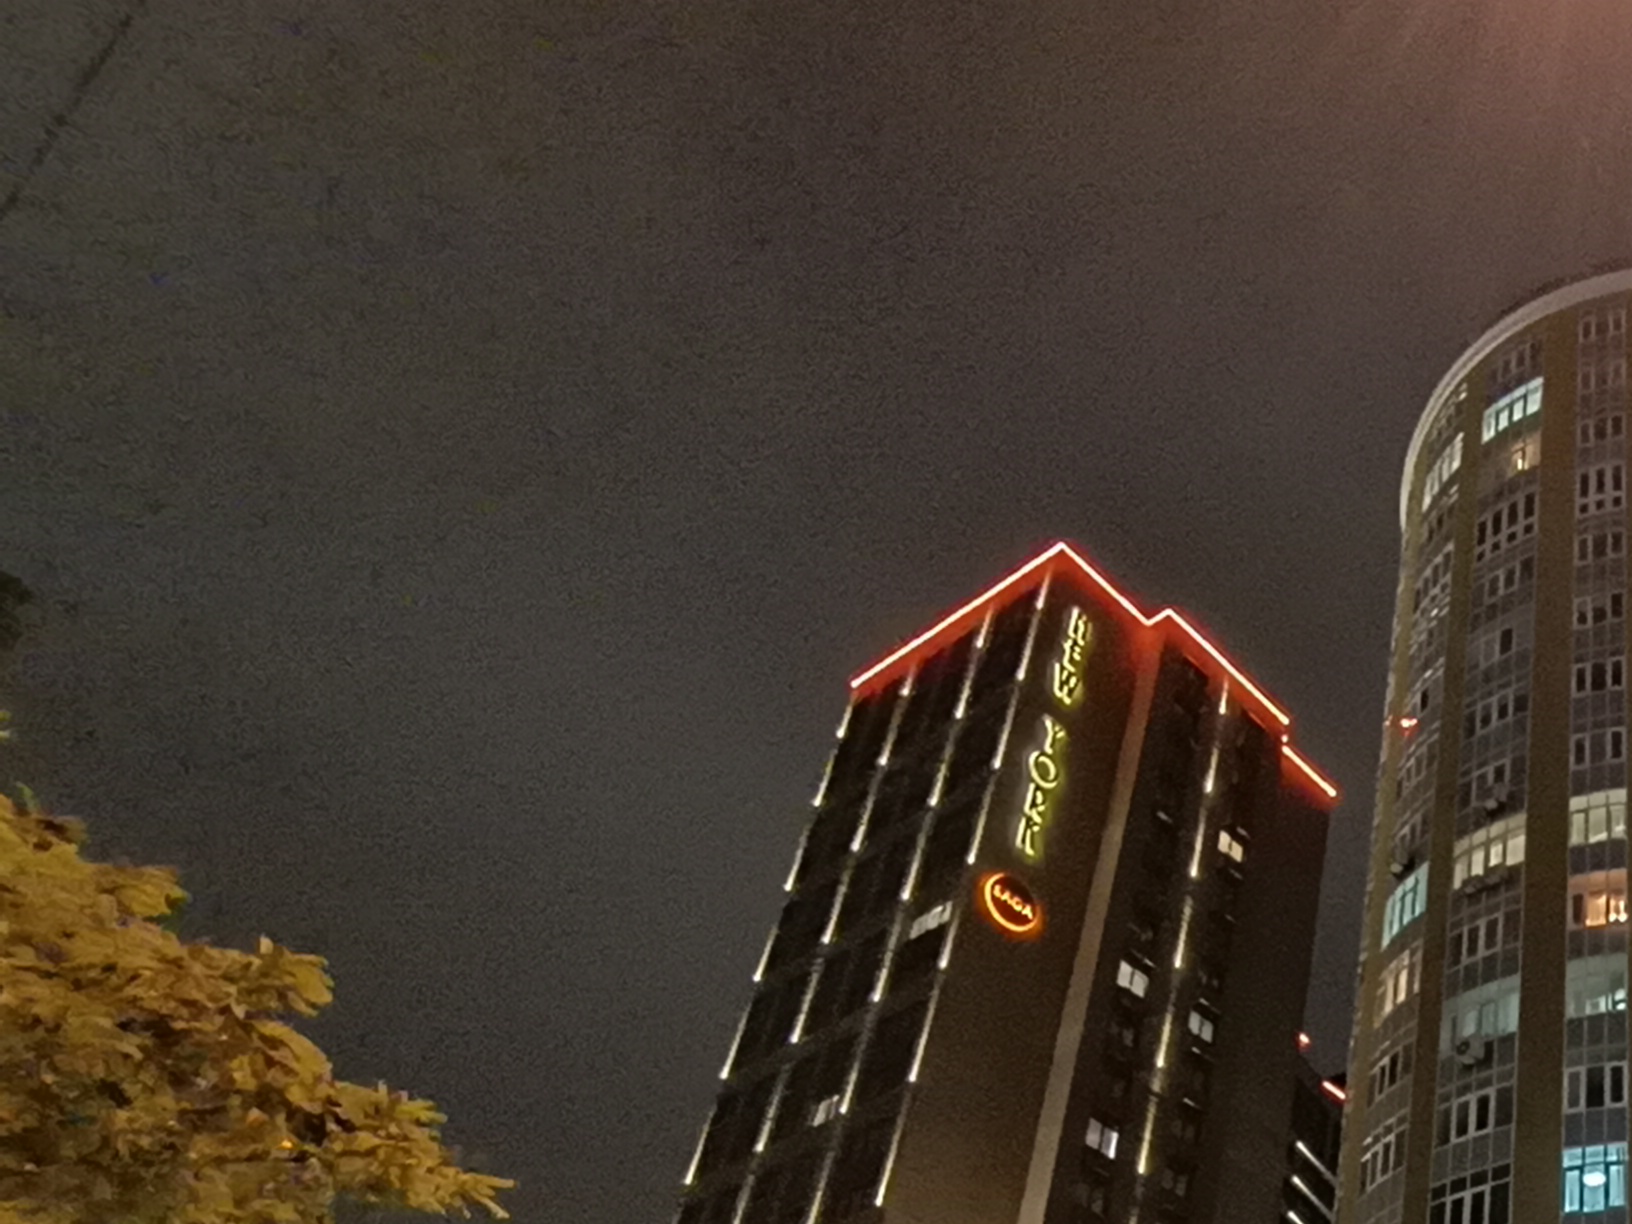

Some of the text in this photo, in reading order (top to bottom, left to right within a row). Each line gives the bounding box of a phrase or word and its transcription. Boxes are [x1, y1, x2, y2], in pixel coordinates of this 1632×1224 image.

[1014, 604, 1089, 856] NEW YORK
[993, 884, 1033, 920] SAGA
